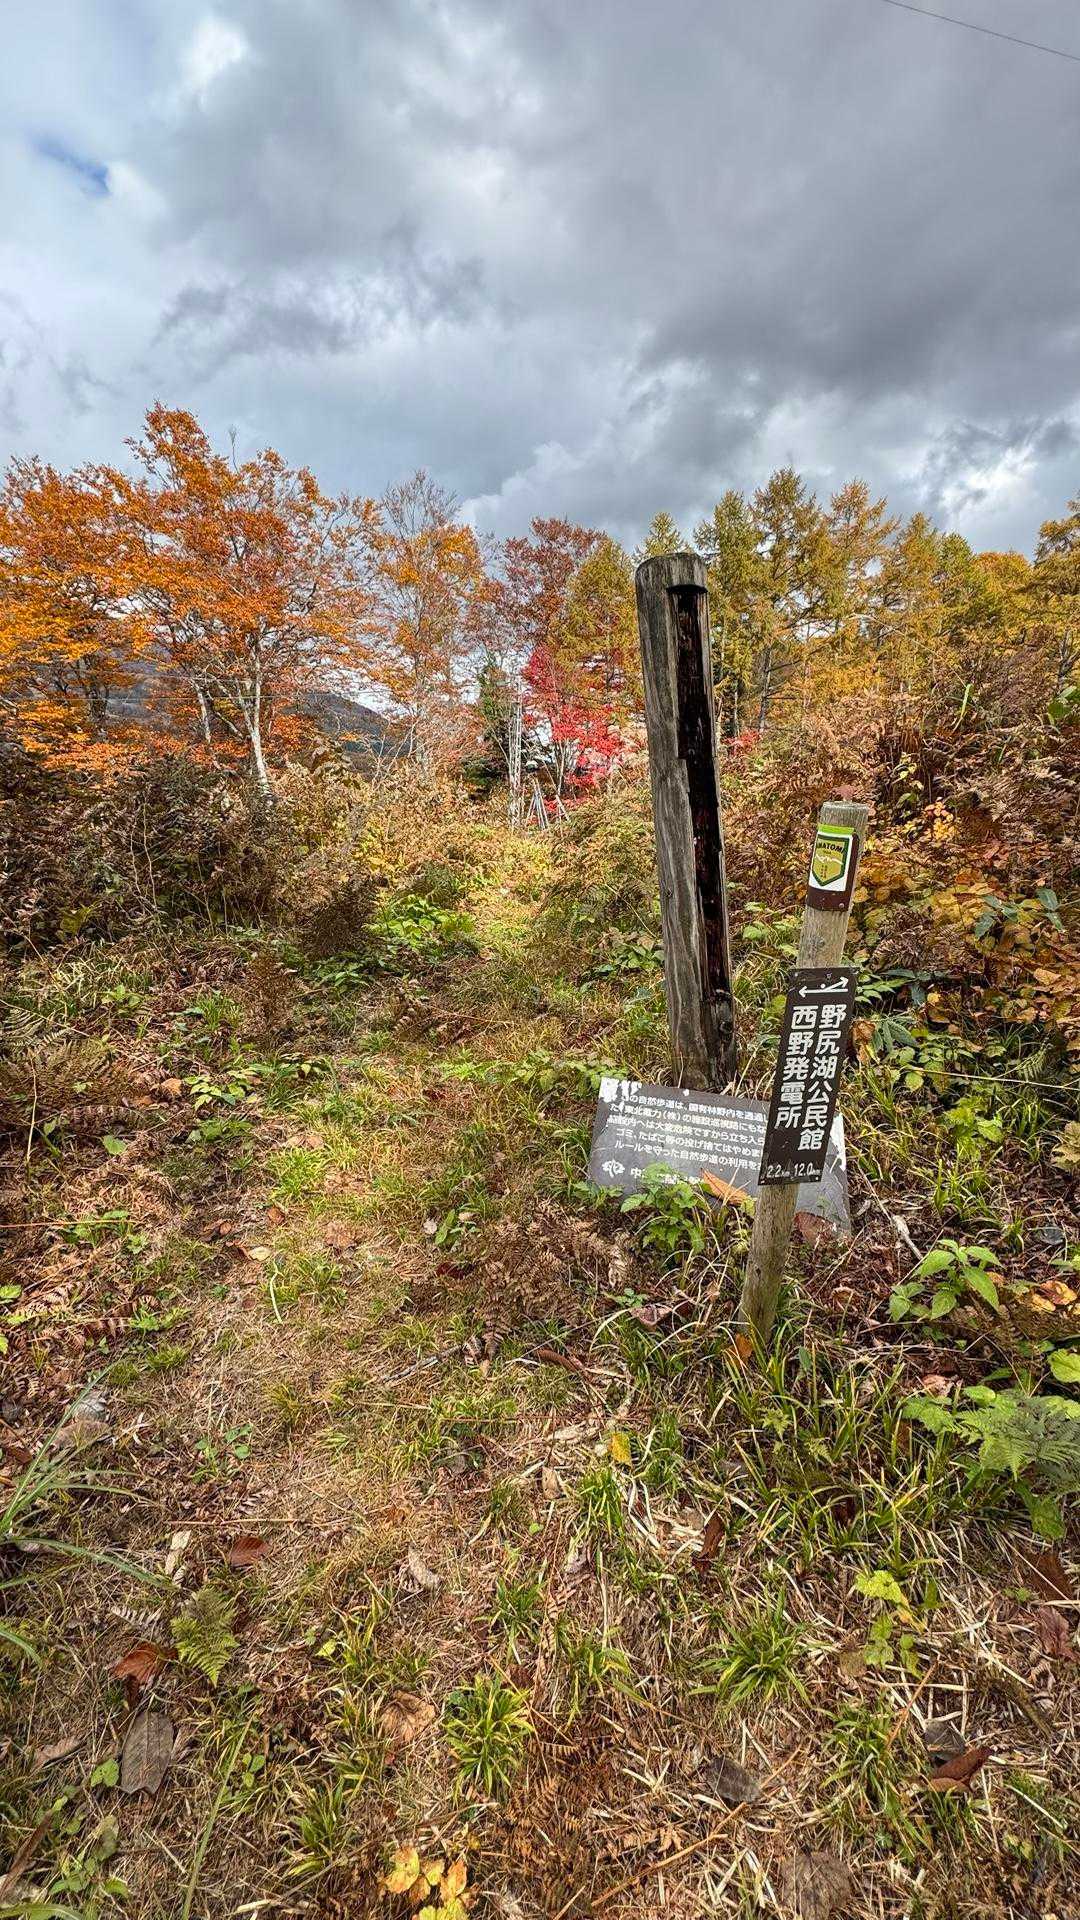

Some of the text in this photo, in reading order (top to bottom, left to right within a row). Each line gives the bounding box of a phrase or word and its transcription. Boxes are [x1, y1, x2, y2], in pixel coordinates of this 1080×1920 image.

[774, 1005, 818, 1129] 西野発電所
[798, 1004, 847, 1151] 野尻湖公民館
